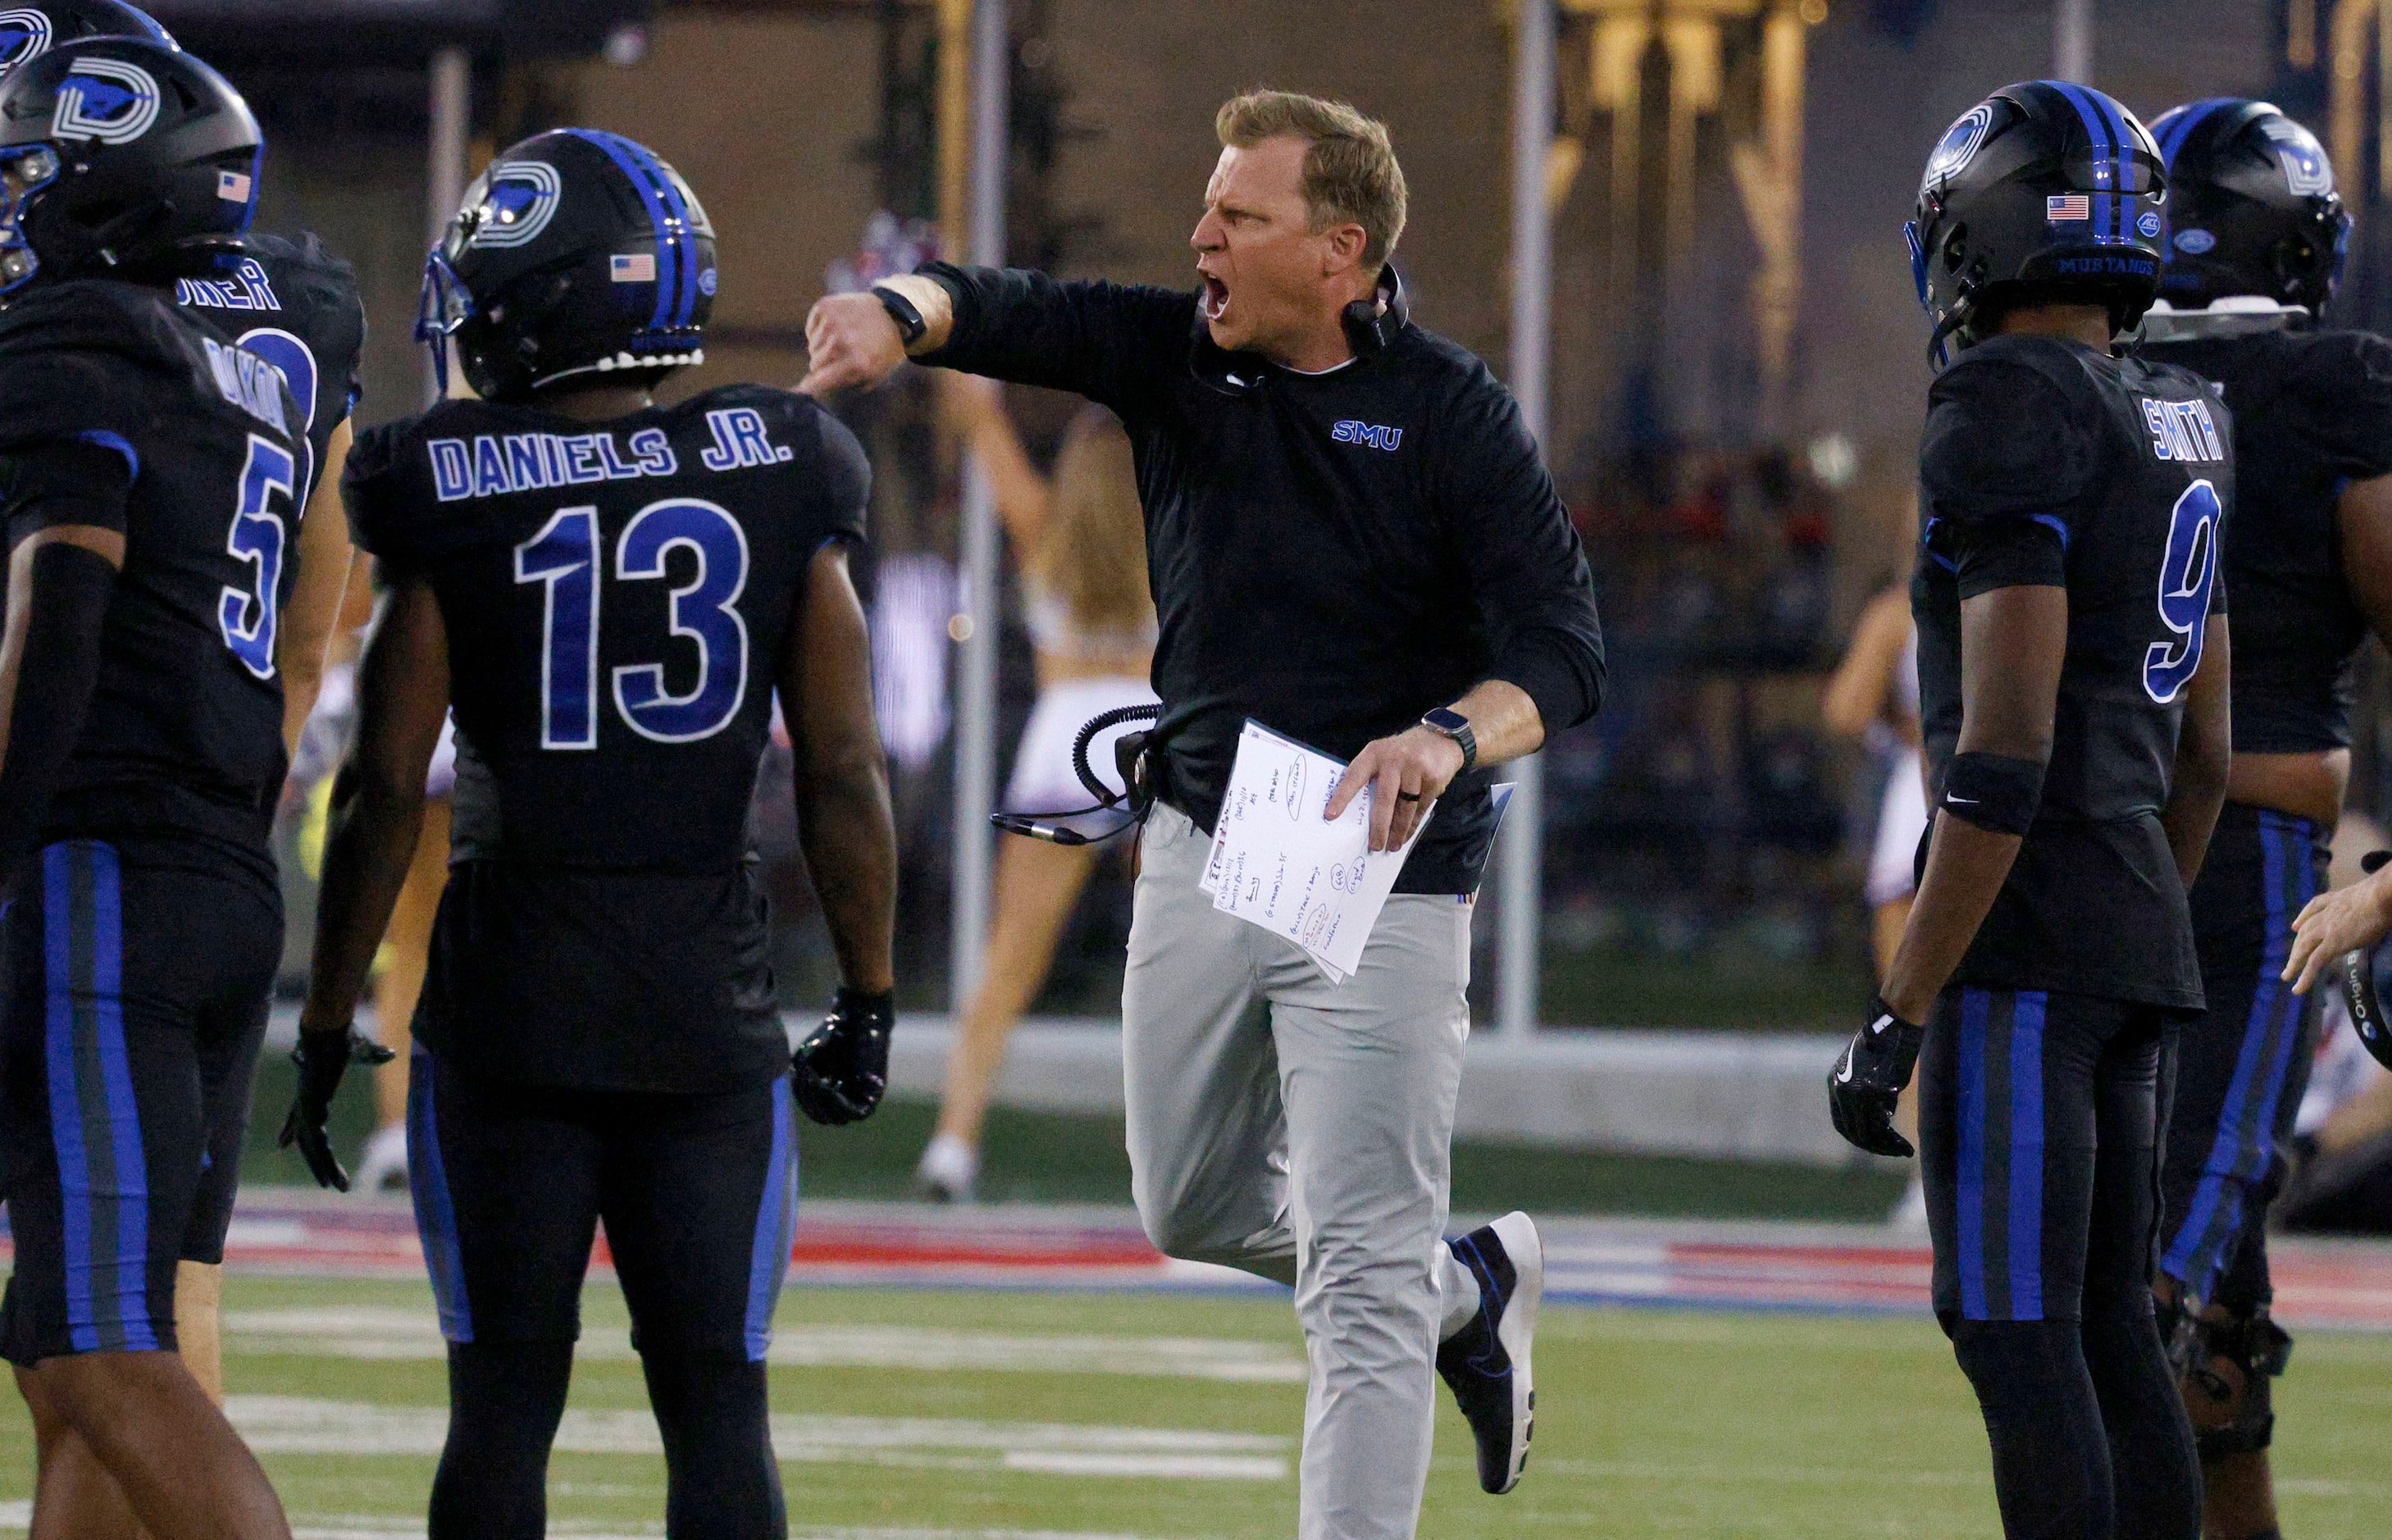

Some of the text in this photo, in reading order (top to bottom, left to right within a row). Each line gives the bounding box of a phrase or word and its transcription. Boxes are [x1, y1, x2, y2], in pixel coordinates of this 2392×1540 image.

[2140, 217, 2158, 228] ACC
[2058, 257, 2155, 276] MUSTANGS
[426, 408, 794, 502] DANIELS JR.
[1331, 419, 1403, 451] SMU
[2142, 398, 2224, 462] SMITH
[217, 431, 294, 680] 5
[2143, 478, 2221, 704] 9
[513, 497, 750, 750] 13
[2349, 968, 2367, 1019] Origin
